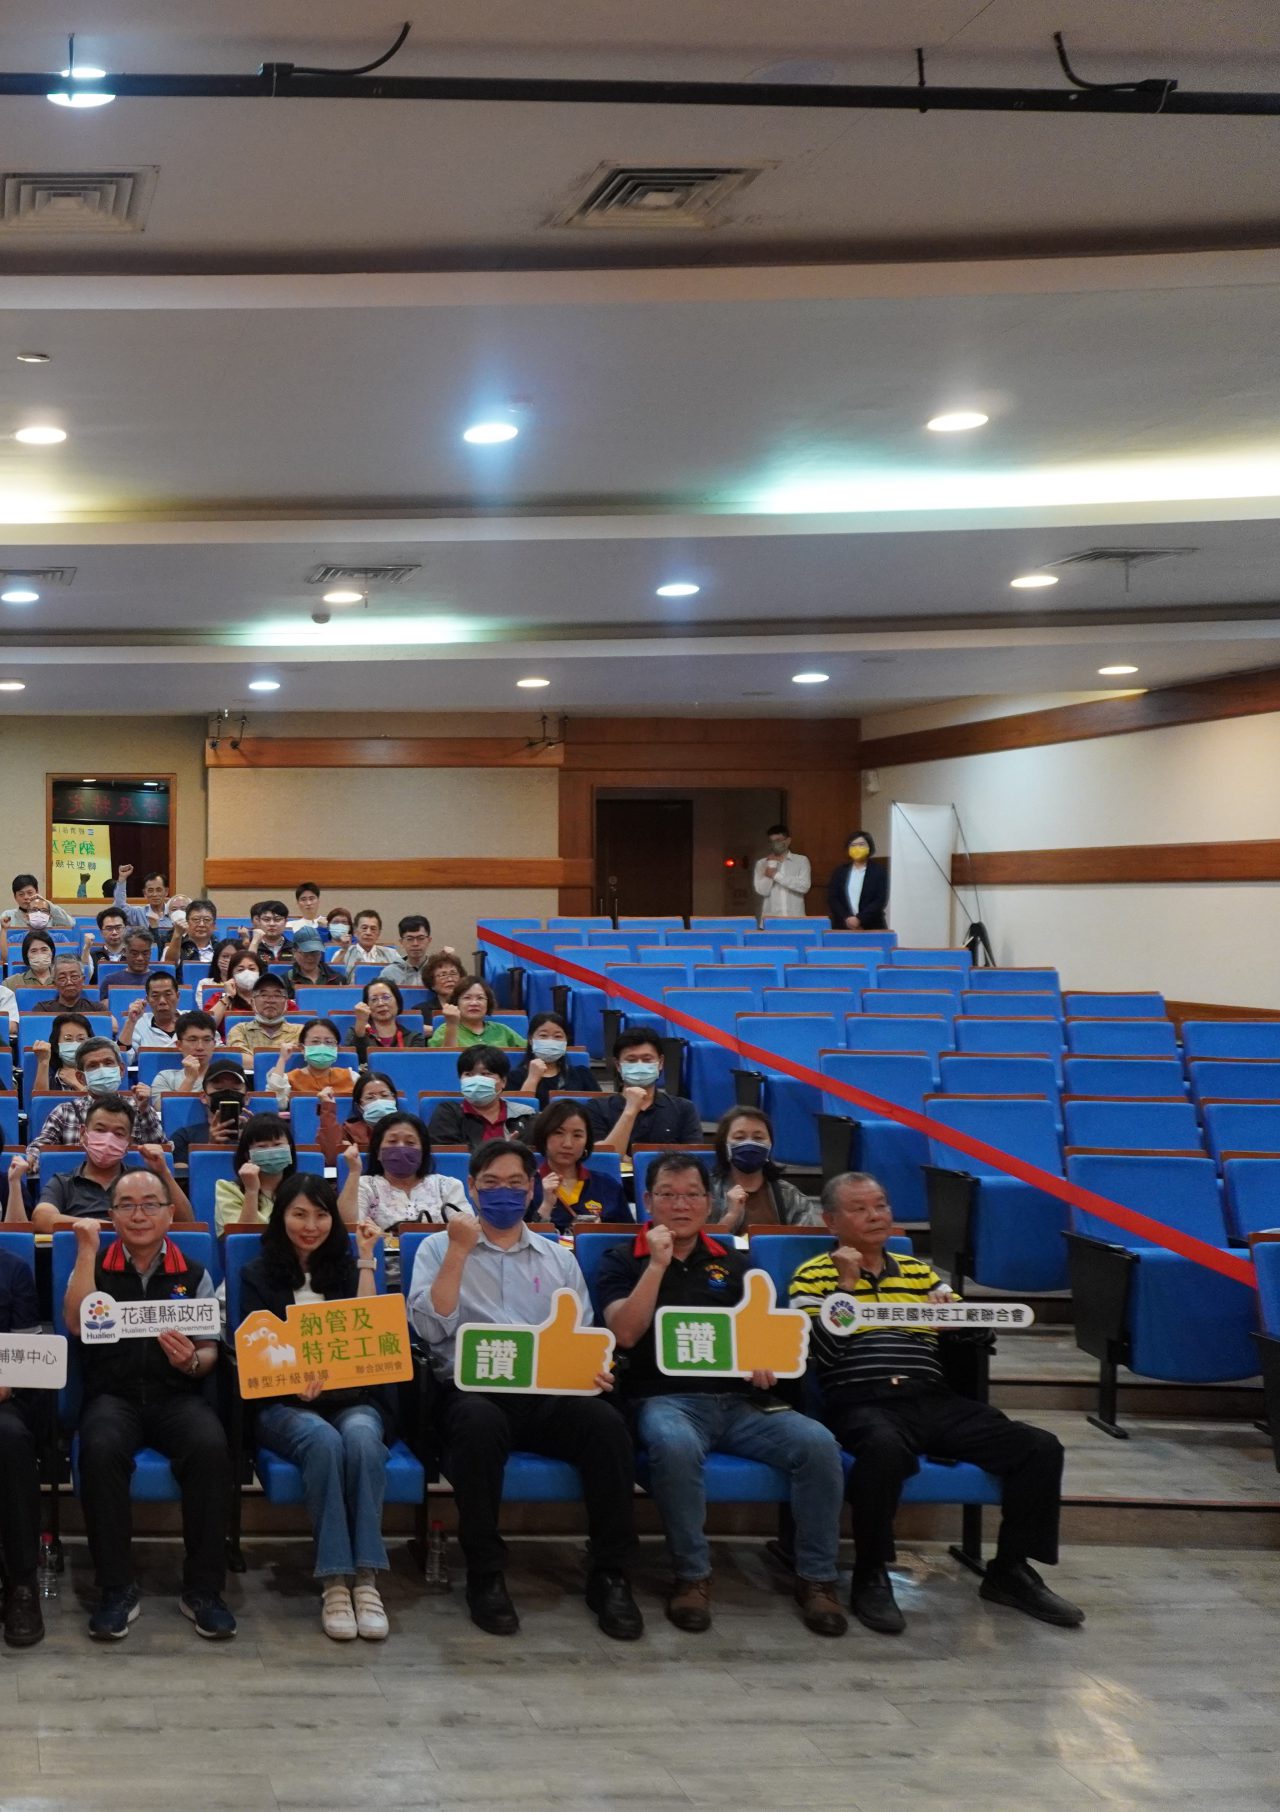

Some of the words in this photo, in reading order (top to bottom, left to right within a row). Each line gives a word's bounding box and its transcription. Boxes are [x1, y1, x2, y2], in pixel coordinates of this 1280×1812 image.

[121, 1304, 214, 1325] 花蓮縣政府
[300, 1308, 373, 1337] 納管及
[861, 1308, 1025, 1323] 中華民國特定工廠聯合會
[86, 1331, 116, 1340] Hualien
[674, 1322, 717, 1364] 讚
[302, 1332, 402, 1365] 特定工廠
[355, 1360, 403, 1375] 聯合說明會
[475, 1339, 518, 1381] 讚
[247, 1369, 330, 1390] 轉型升級輔導
